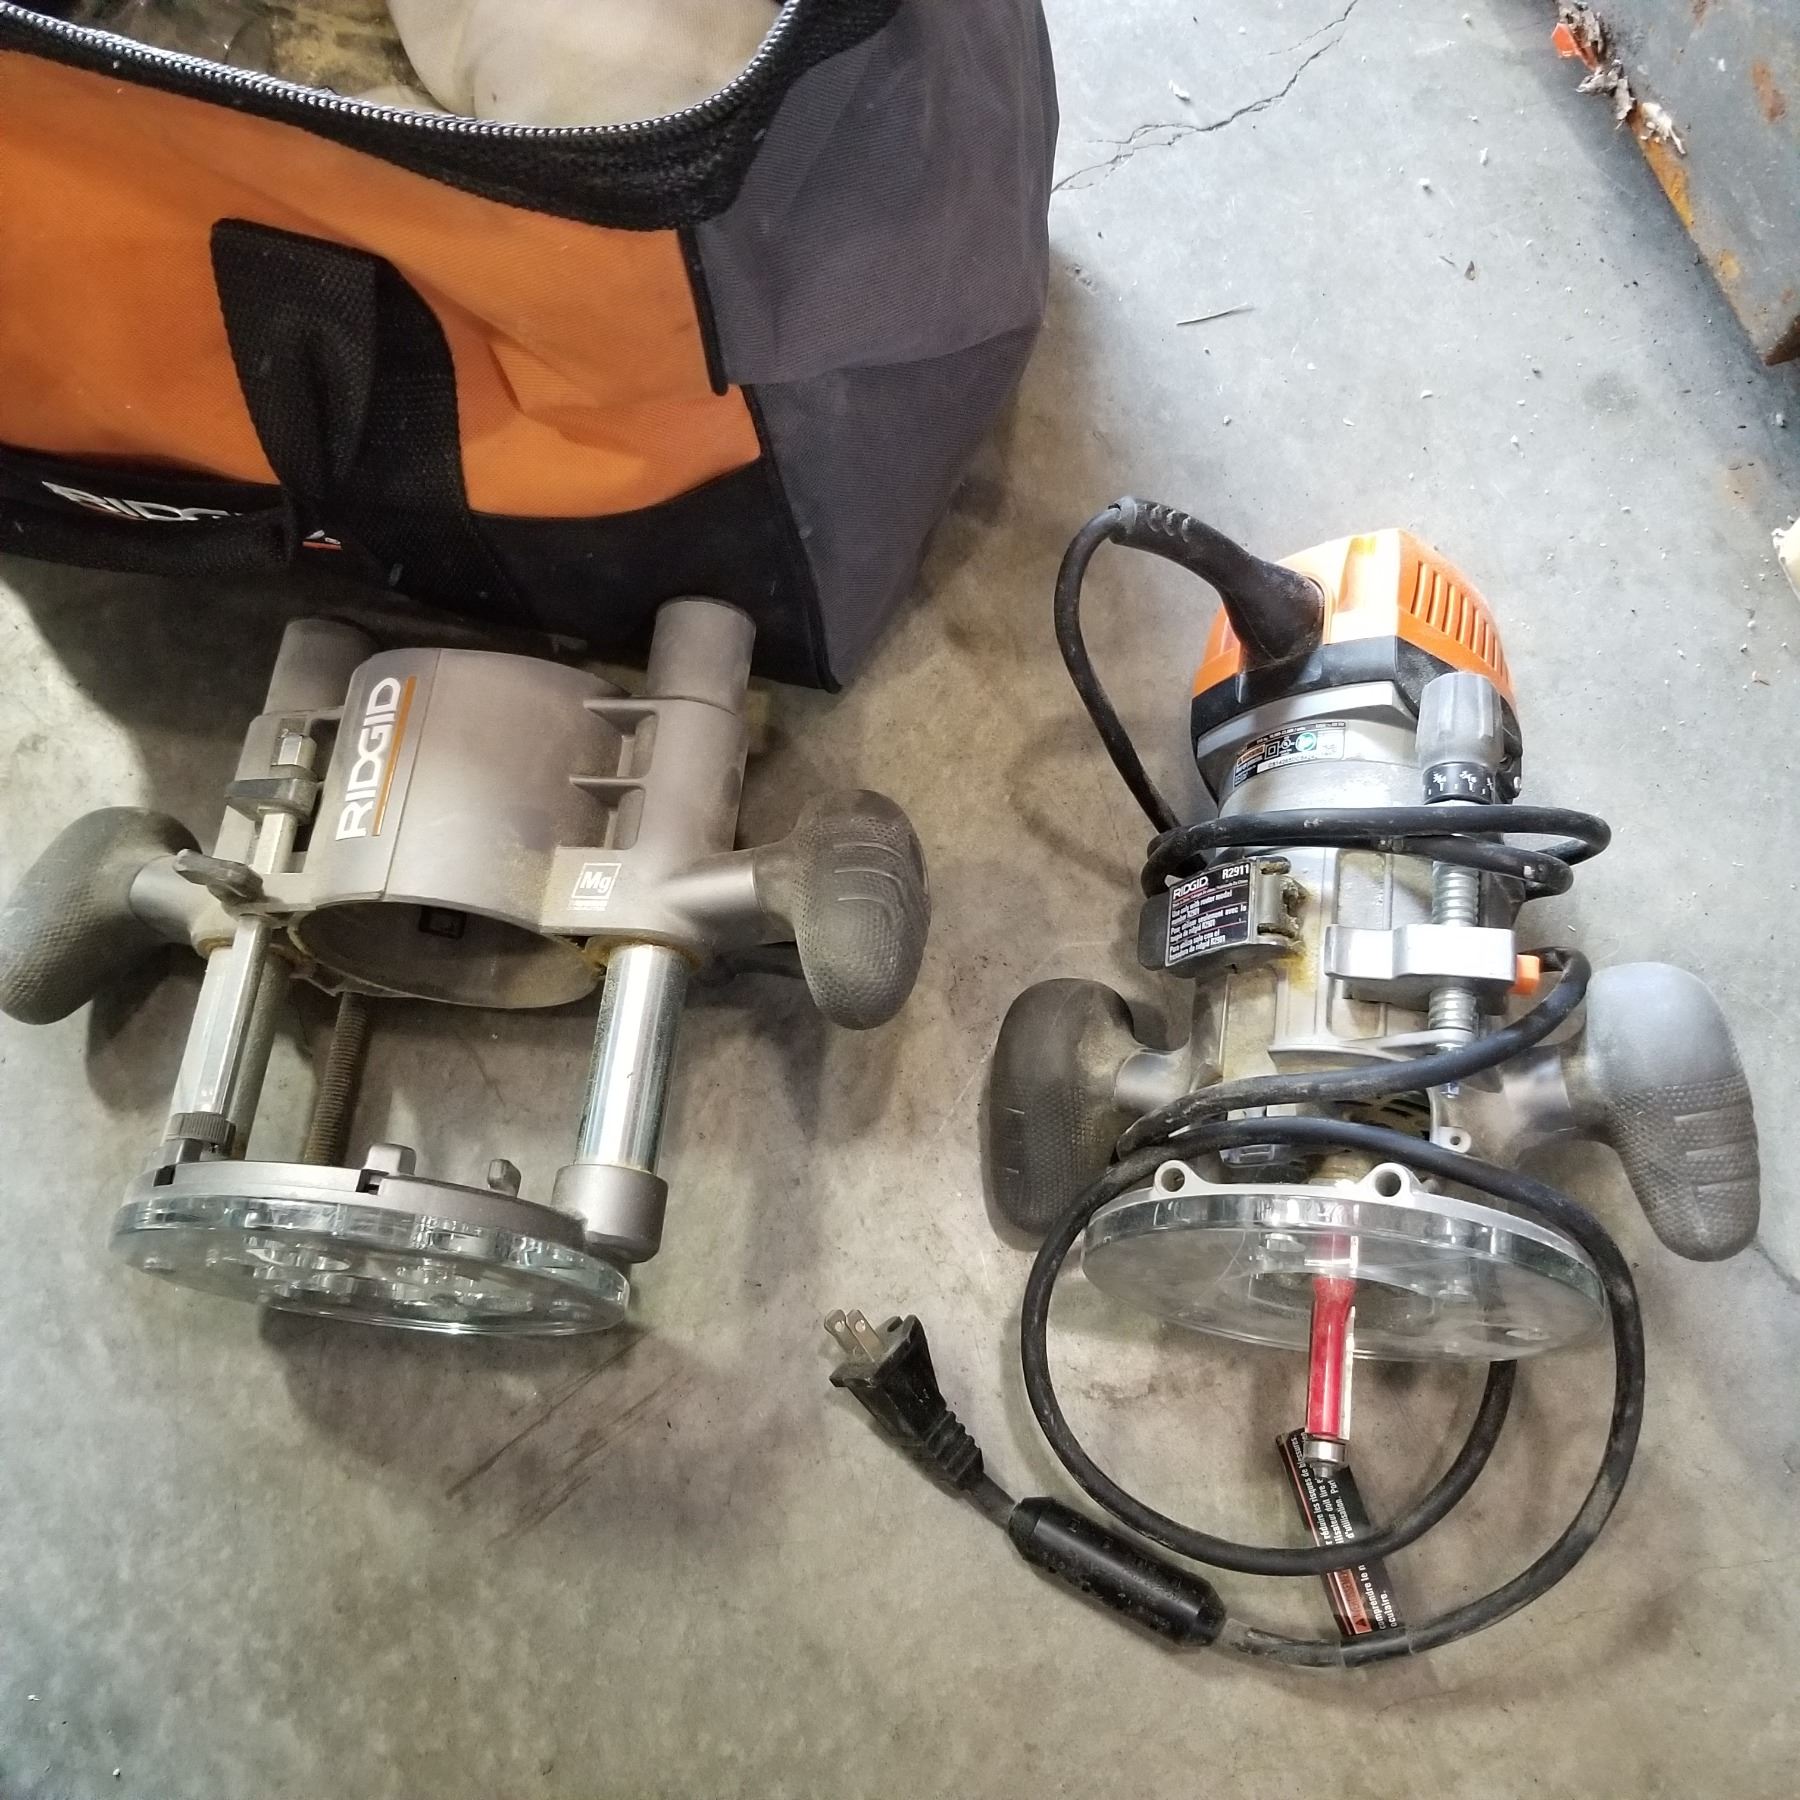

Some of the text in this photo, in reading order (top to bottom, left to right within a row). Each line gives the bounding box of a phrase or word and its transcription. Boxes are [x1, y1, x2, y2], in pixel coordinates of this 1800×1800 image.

[336, 677, 403, 841] RIDGID
[580, 871, 612, 893] Mg
[1173, 876, 1208, 899] RIDGID
[1222, 864, 1250, 880] R2911
[1300, 1468, 1308, 1477] de
[1303, 1477, 1317, 1502] risques
[1318, 1485, 1328, 1497] lire
[1311, 1502, 1321, 1513] les
[1321, 1498, 1333, 1512] doit
[1316, 1513, 1331, 1539] réduire
[1328, 1512, 1344, 1544] ilisateur
[1360, 1572, 1369, 1581] le
[1363, 1582, 1385, 1629] comprendre
[1380, 1590, 1397, 1627] oculaire.
